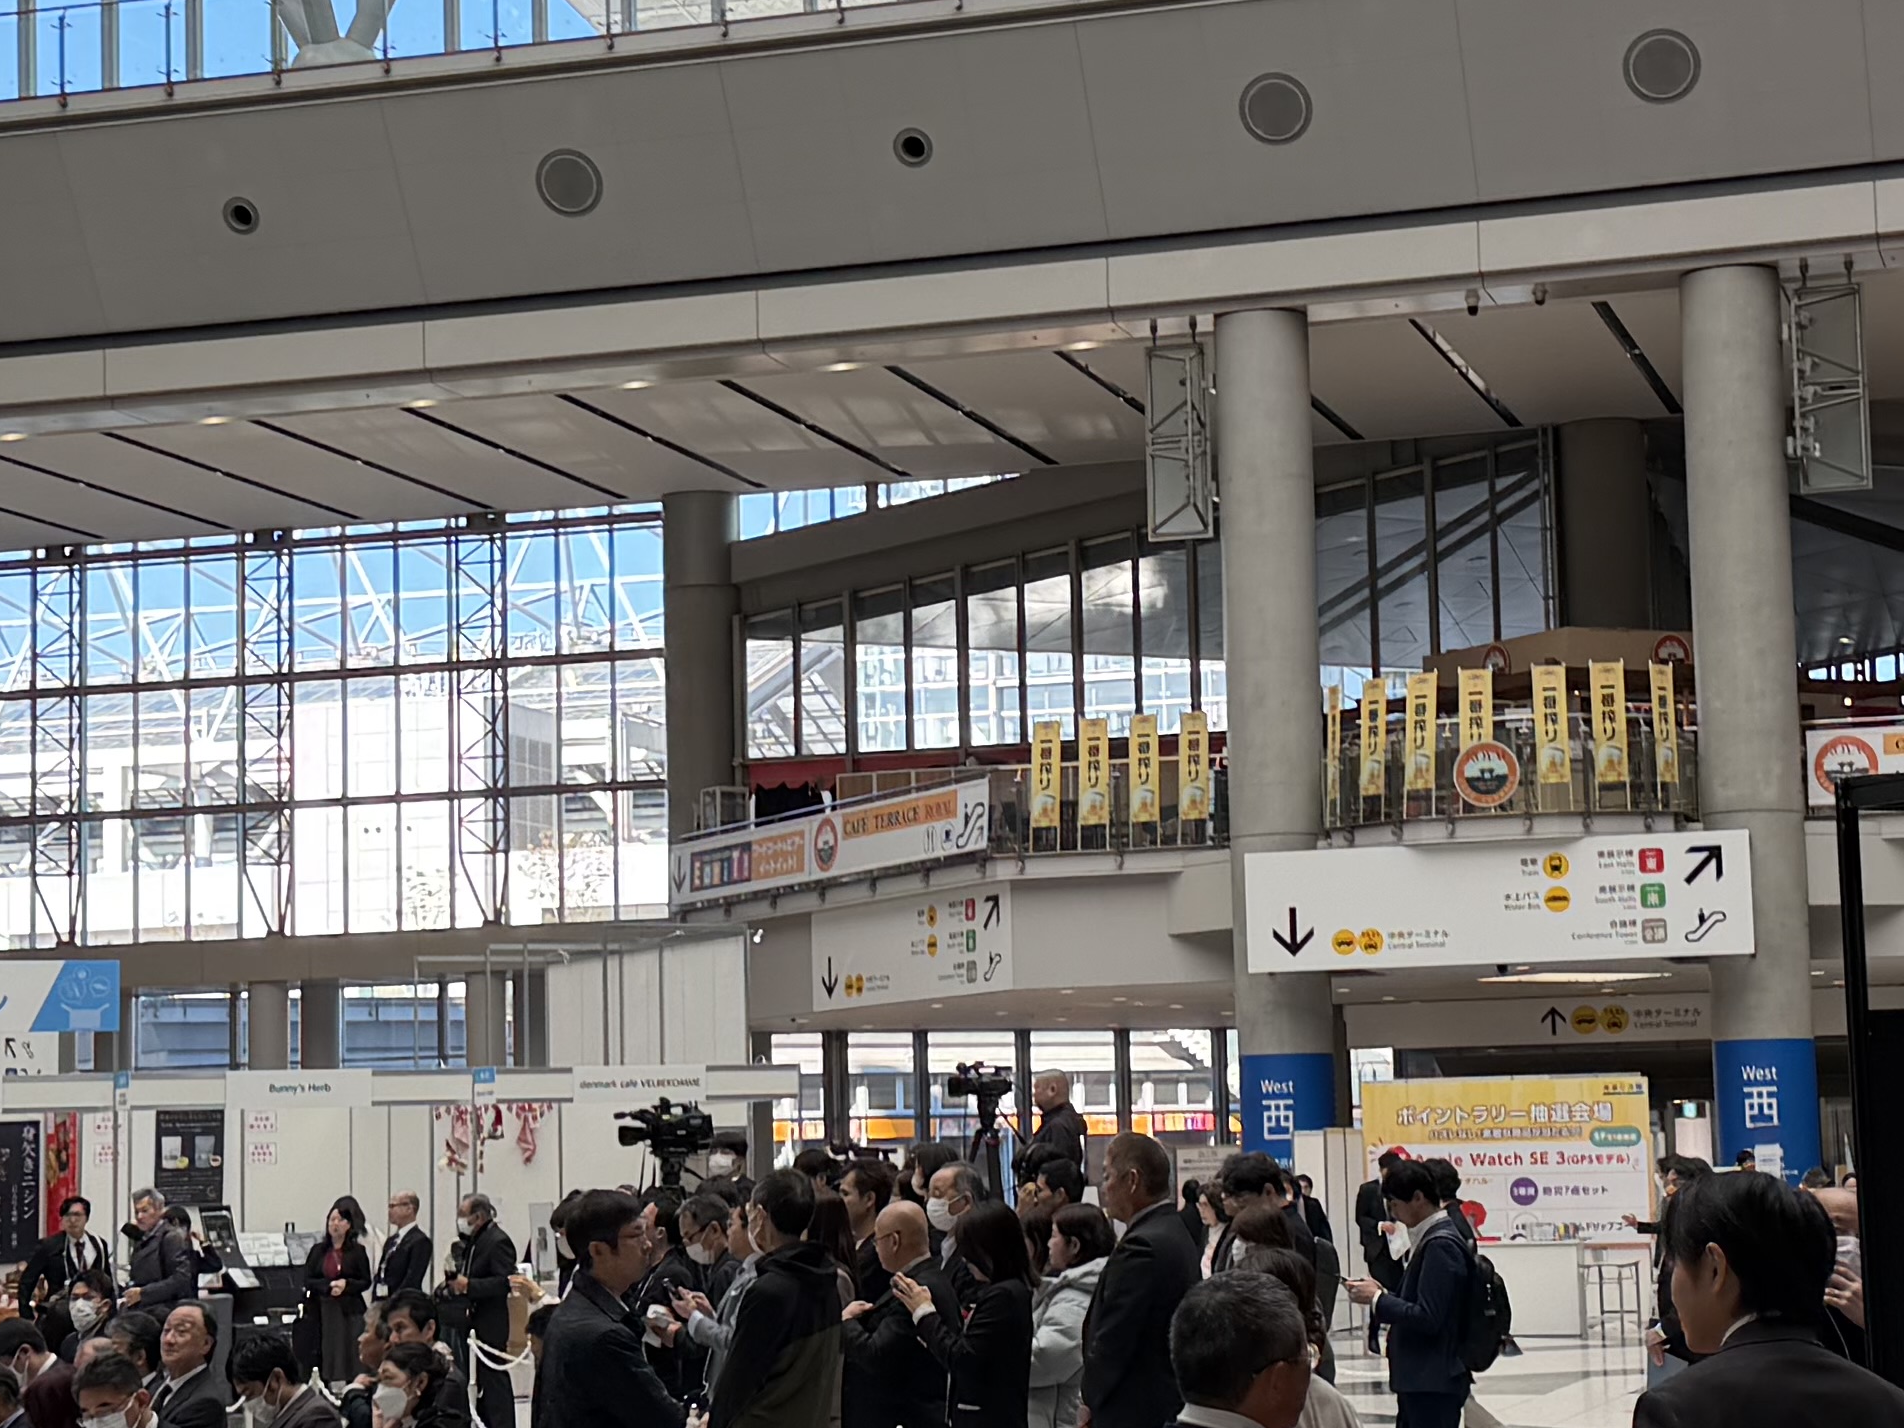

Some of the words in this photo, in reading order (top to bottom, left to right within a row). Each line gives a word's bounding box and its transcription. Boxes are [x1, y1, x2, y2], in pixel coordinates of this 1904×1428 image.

[874, 806, 921, 830] TERRACE
[1741, 1065, 1778, 1081] West
[308, 1083, 331, 1093] Herb
[1260, 1079, 1294, 1094] West
[1397, 1102, 1613, 1124] ポイントラリー抽選会場
[1743, 1085, 1780, 1129] 西
[1262, 1099, 1294, 1140] 西
[1470, 1152, 1524, 1168] Watch
[1530, 1152, 1549, 1166] SE
